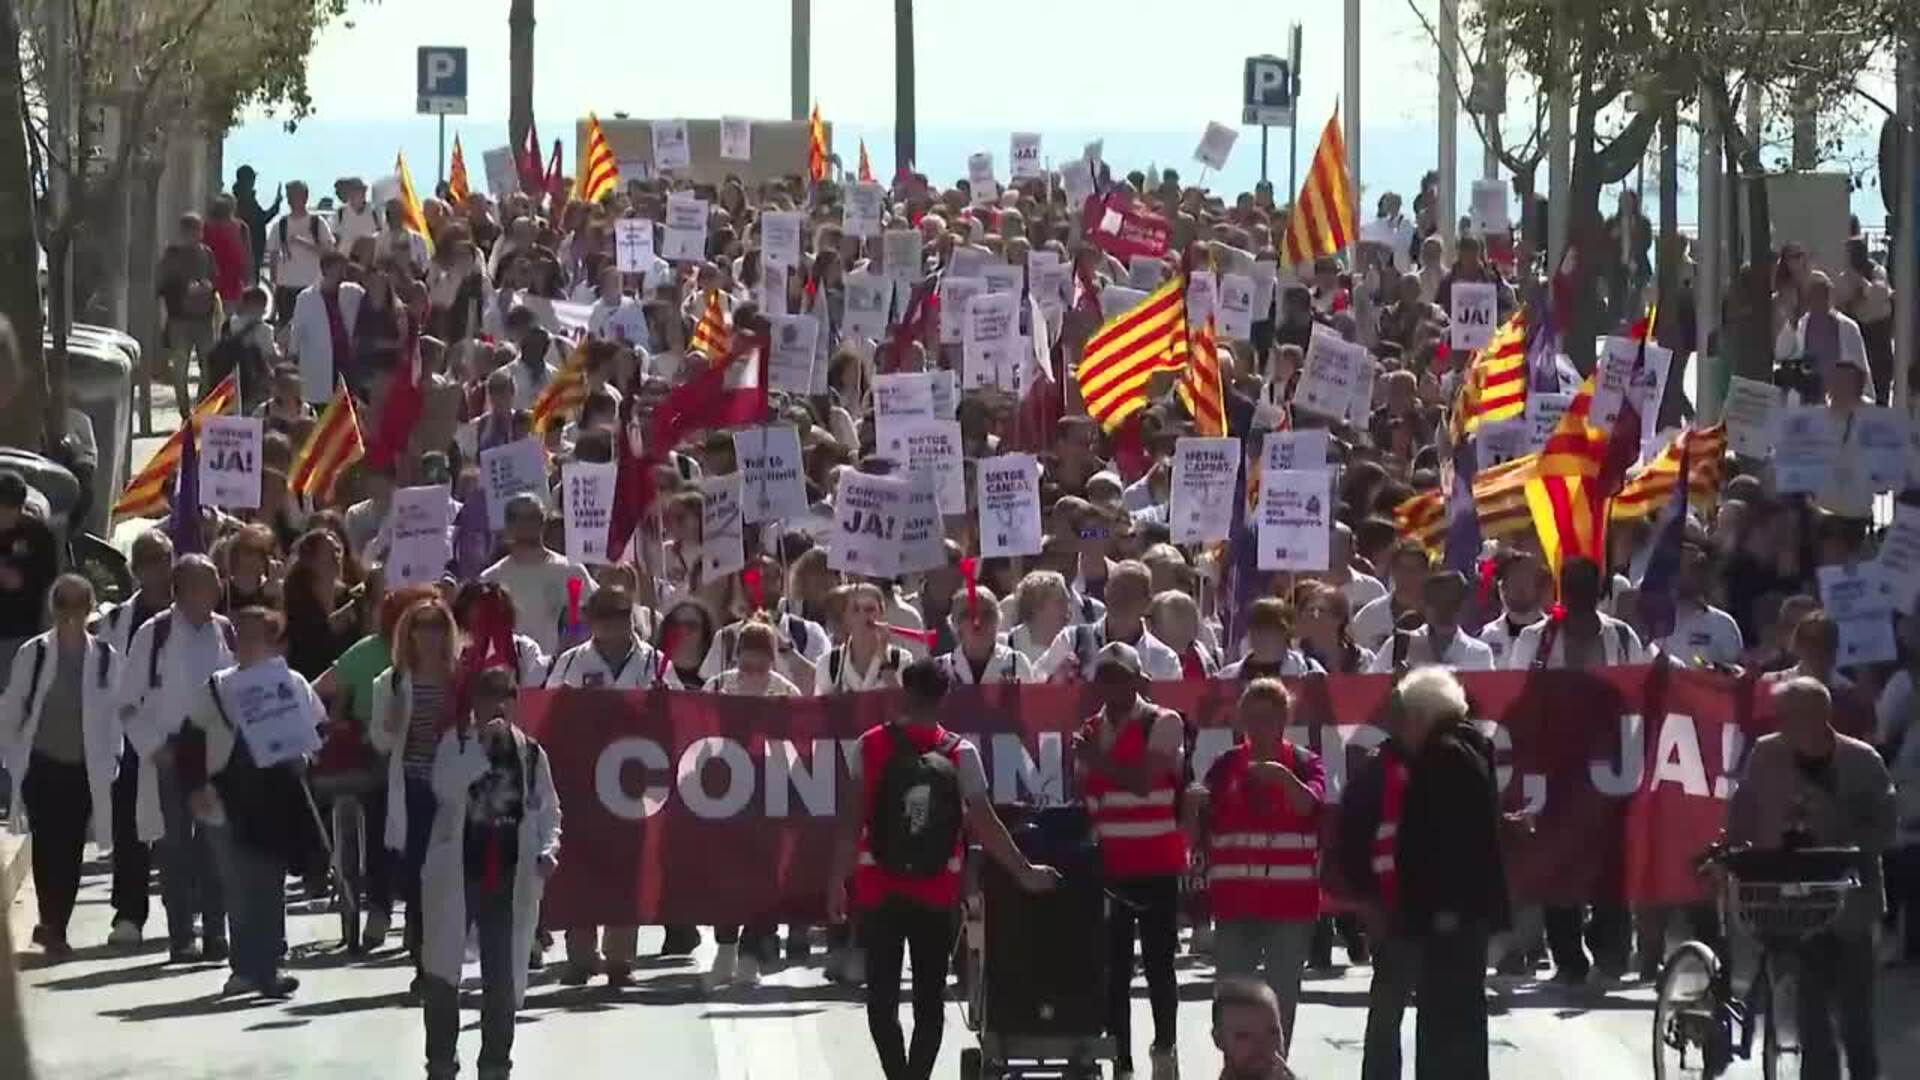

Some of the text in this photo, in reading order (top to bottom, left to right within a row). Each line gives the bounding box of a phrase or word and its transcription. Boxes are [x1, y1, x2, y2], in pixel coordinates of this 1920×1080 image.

[427, 52, 456, 91] P
[1254, 62, 1283, 101] P
[1458, 308, 1489, 325] JA!
[209, 449, 253, 473] JA!
[842, 509, 896, 541] JA!
[1589, 712, 1747, 800] JA!
